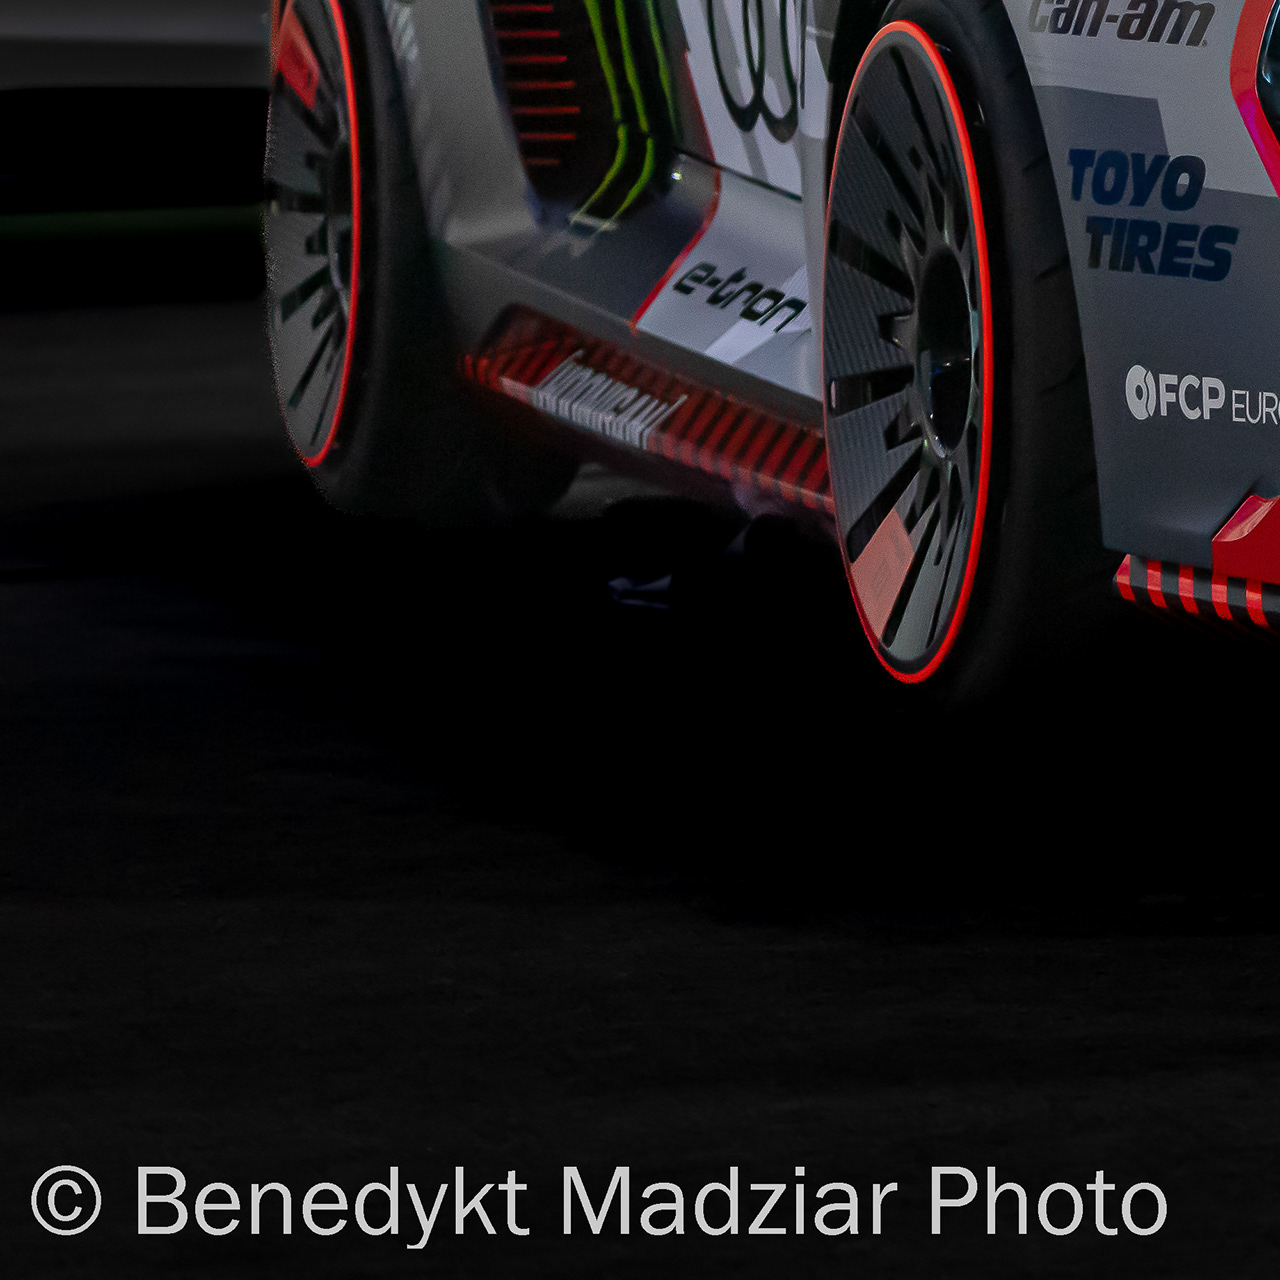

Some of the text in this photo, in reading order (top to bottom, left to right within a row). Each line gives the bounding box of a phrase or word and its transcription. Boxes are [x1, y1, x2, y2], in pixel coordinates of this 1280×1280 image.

[1068, 147, 1206, 211] TOYO
[1085, 216, 1240, 282] TIRES
[673, 260, 807, 334] e-tron
[1159, 372, 1226, 422] FCP
